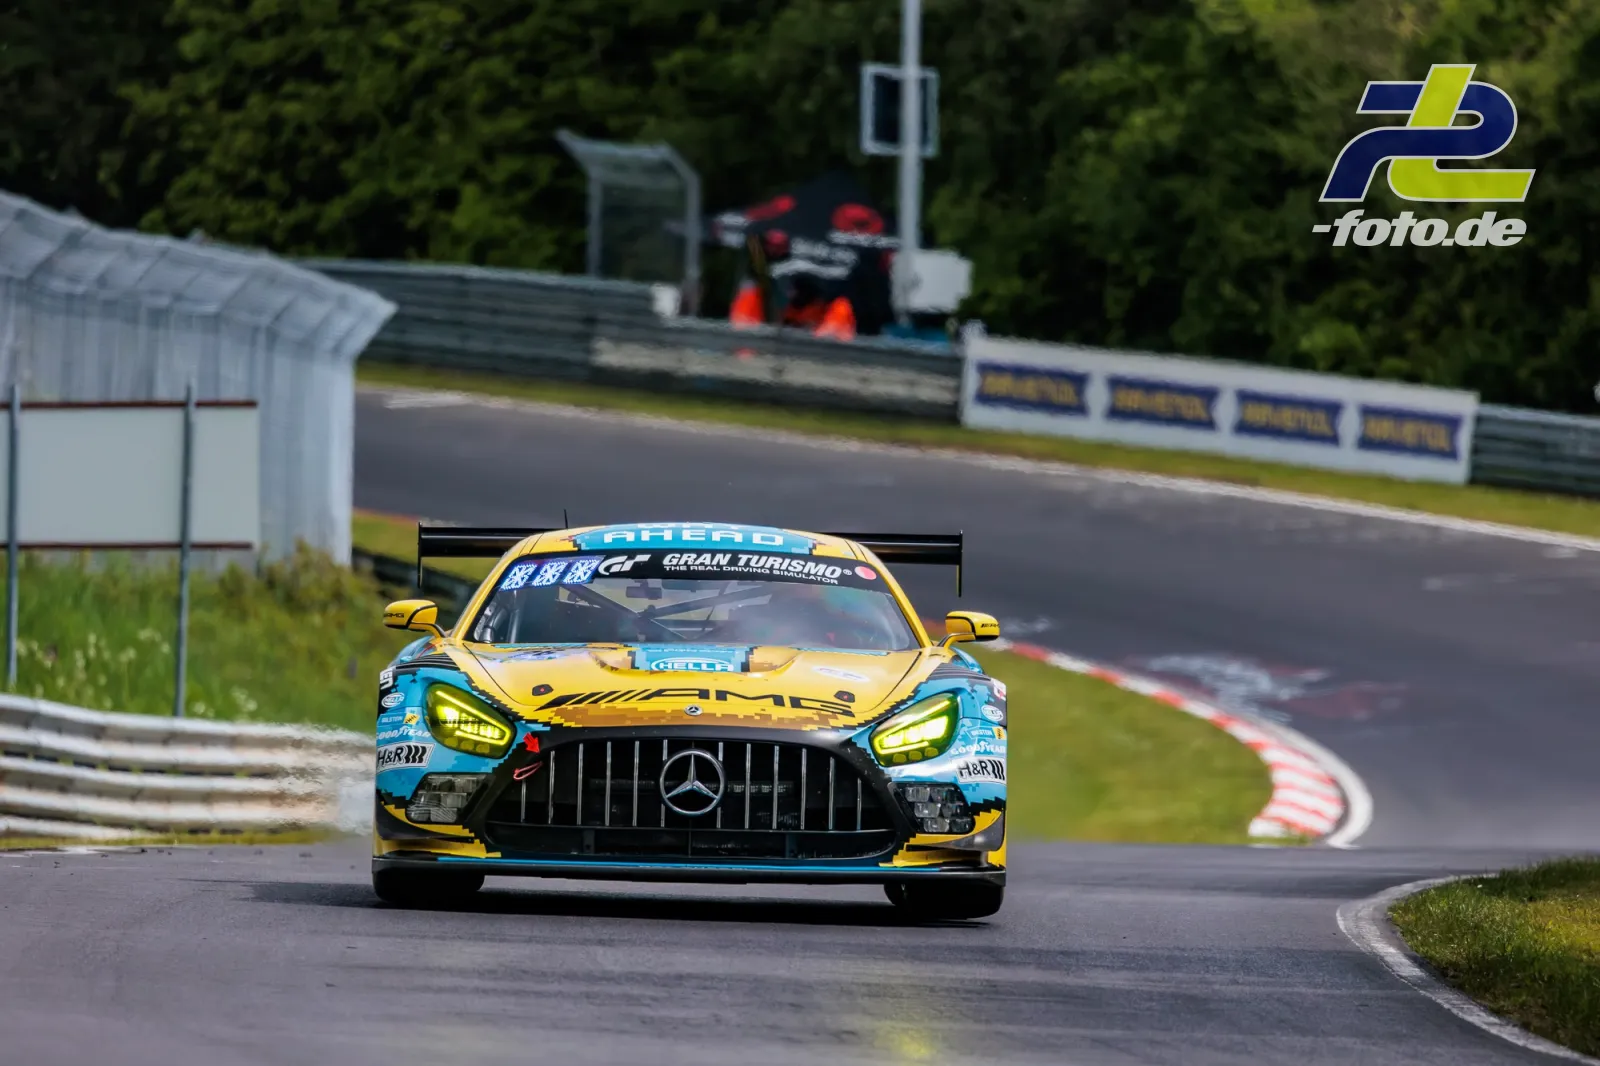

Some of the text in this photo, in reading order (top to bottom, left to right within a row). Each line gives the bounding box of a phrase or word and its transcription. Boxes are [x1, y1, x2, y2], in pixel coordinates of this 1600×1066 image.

[603, 529, 784, 546] AHEAD
[662, 552, 842, 579] GRAN TURISMO
[722, 566, 770, 574] DRIVING
[772, 569, 839, 585] SIMULATOR
[658, 662, 734, 672] HELLA
[637, 688, 856, 718] AMG
[377, 745, 404, 767] H&R
[958, 759, 991, 777] H&R
